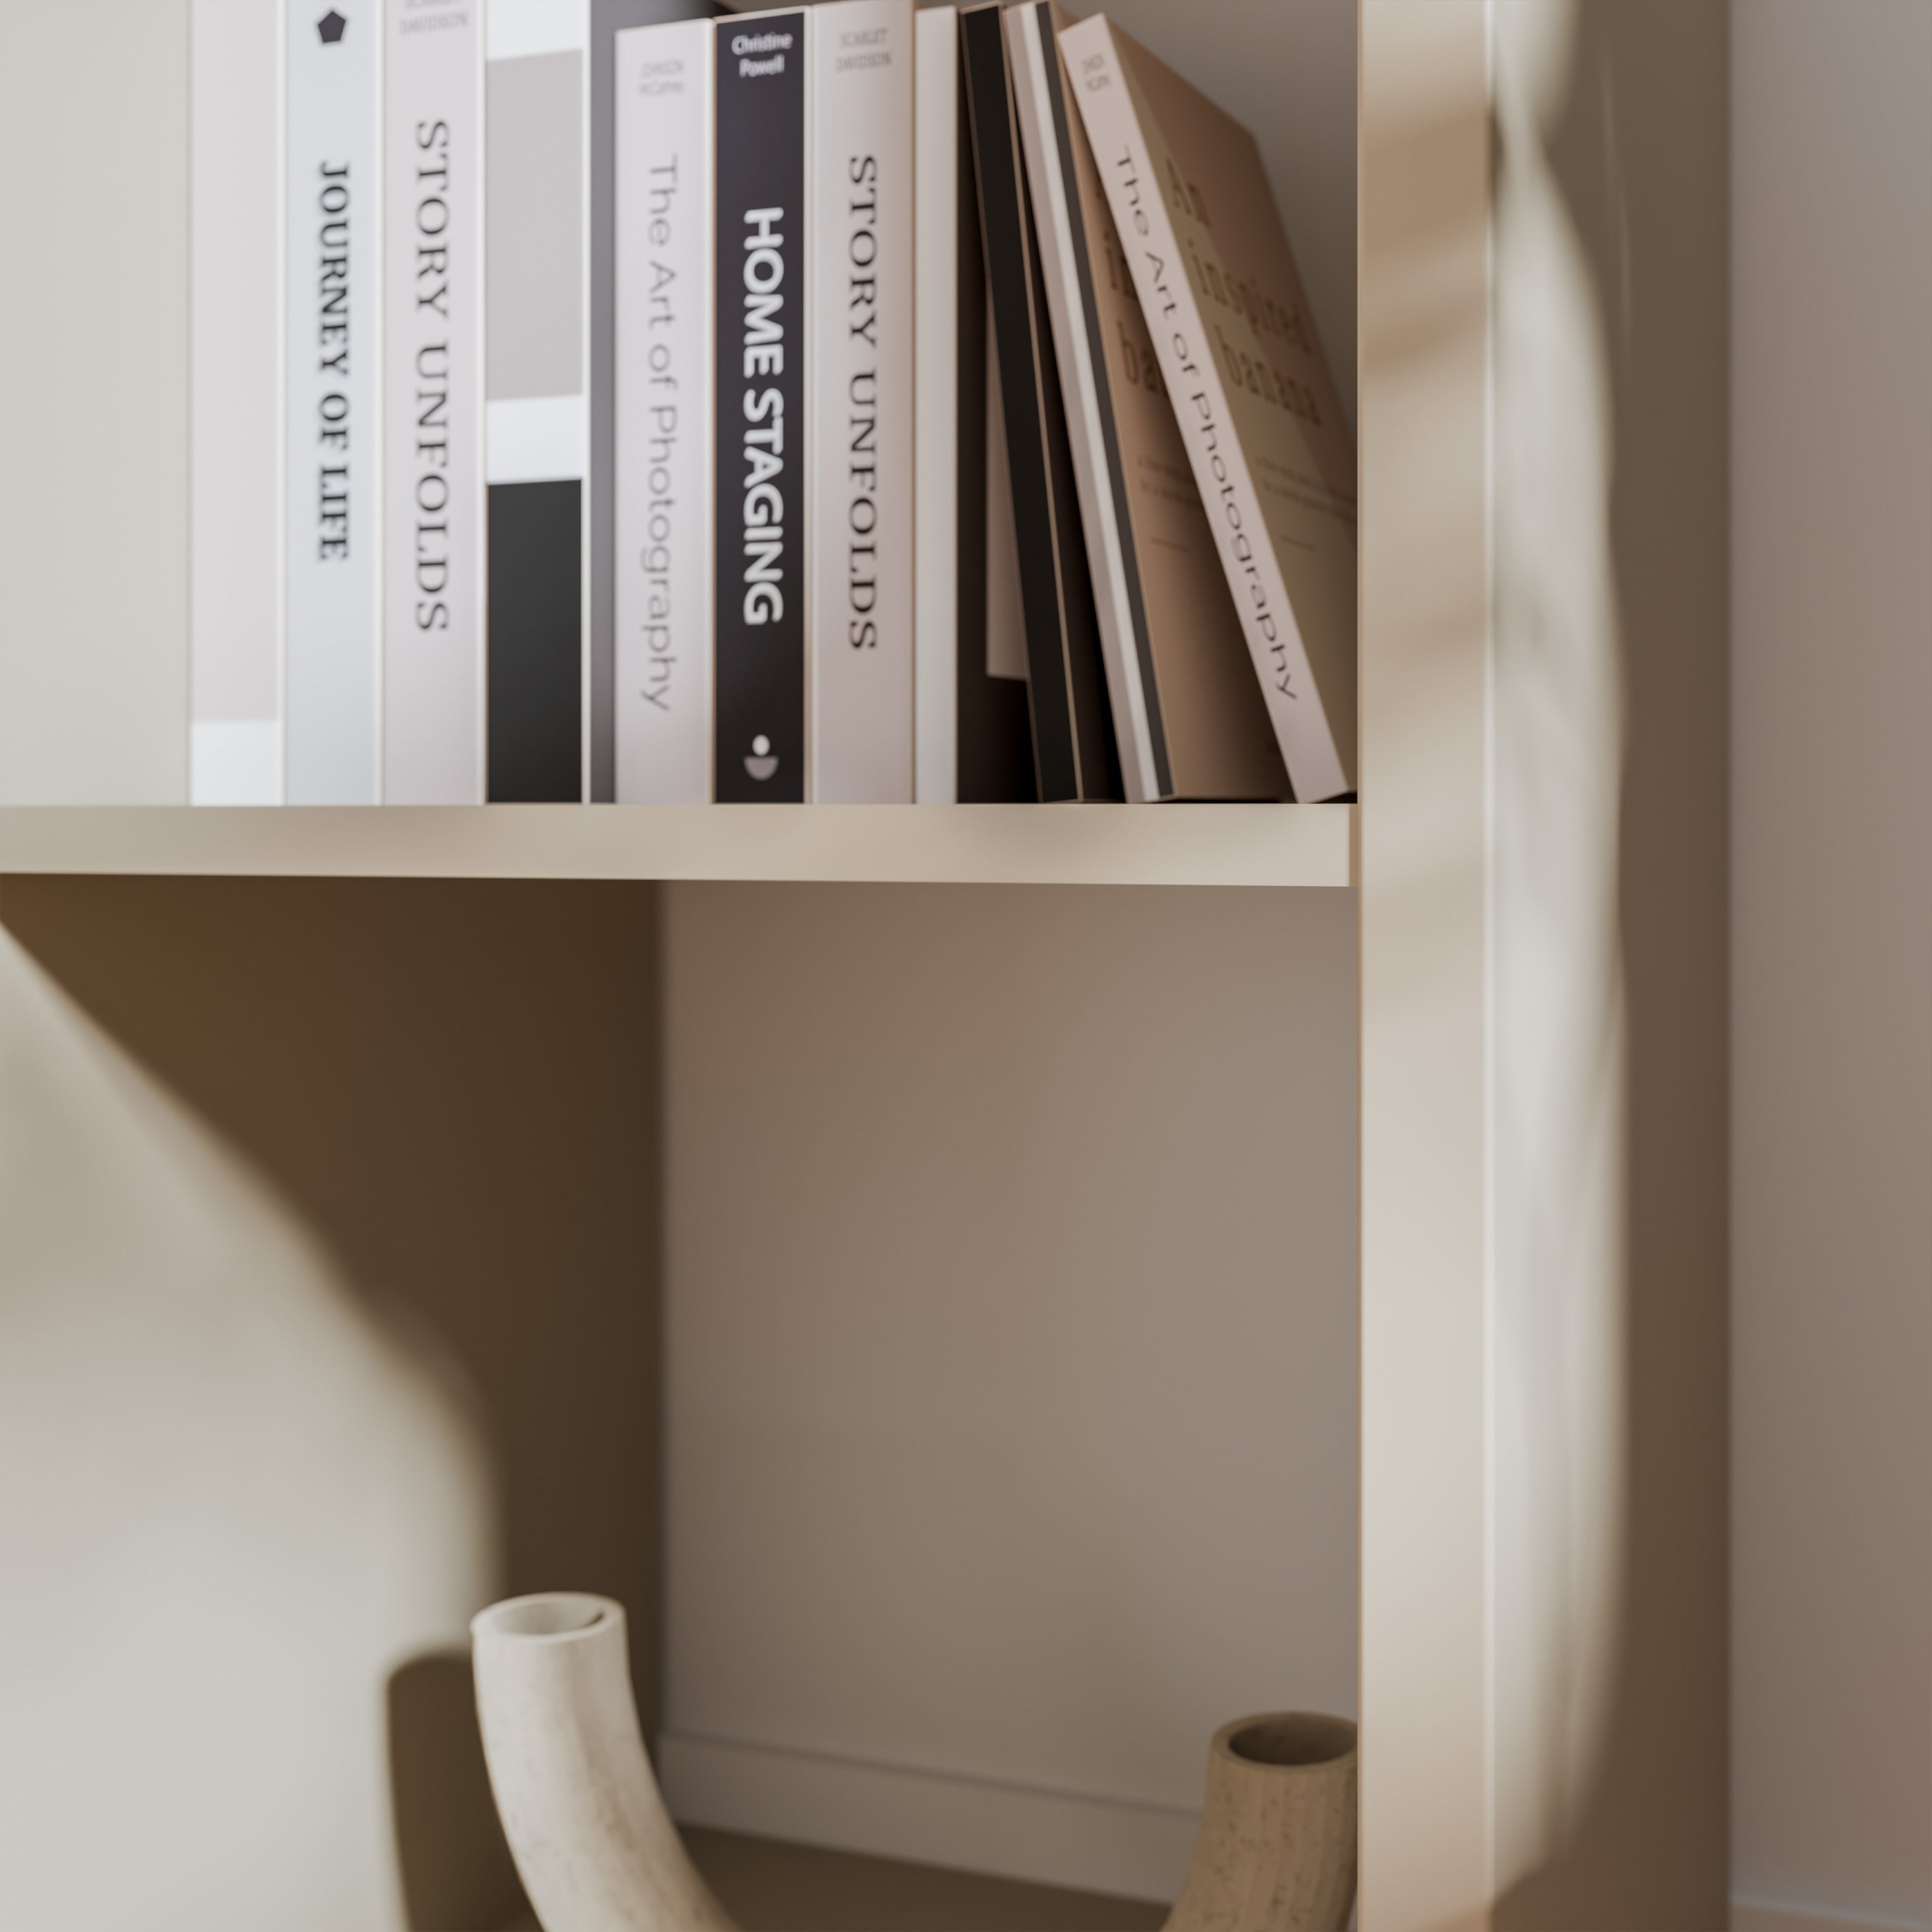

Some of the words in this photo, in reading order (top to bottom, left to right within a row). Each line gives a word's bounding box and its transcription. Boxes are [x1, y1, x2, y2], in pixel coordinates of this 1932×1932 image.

[732, 32, 793, 55] Christine
[739, 54, 785, 78] Powell
[319, 162, 348, 375] JOURNEY
[417, 120, 448, 316] STORY
[650, 155, 678, 247] The
[849, 155, 877, 346] STORY
[649, 344, 678, 390] of
[650, 261, 678, 327] Art
[743, 207, 784, 379] HOME
[319, 392, 348, 450] OF
[417, 343, 448, 630] UNFOLDS
[743, 388, 784, 625] STAGING
[849, 370, 877, 649] UNFOLDS
[1117, 145, 1151, 237] The
[1146, 250, 1178, 319] Art
[1172, 332, 1202, 379] of
[1191, 391, 1298, 700] Photography
[319, 464, 348, 560] LIFE
[641, 405, 677, 711] Photography
